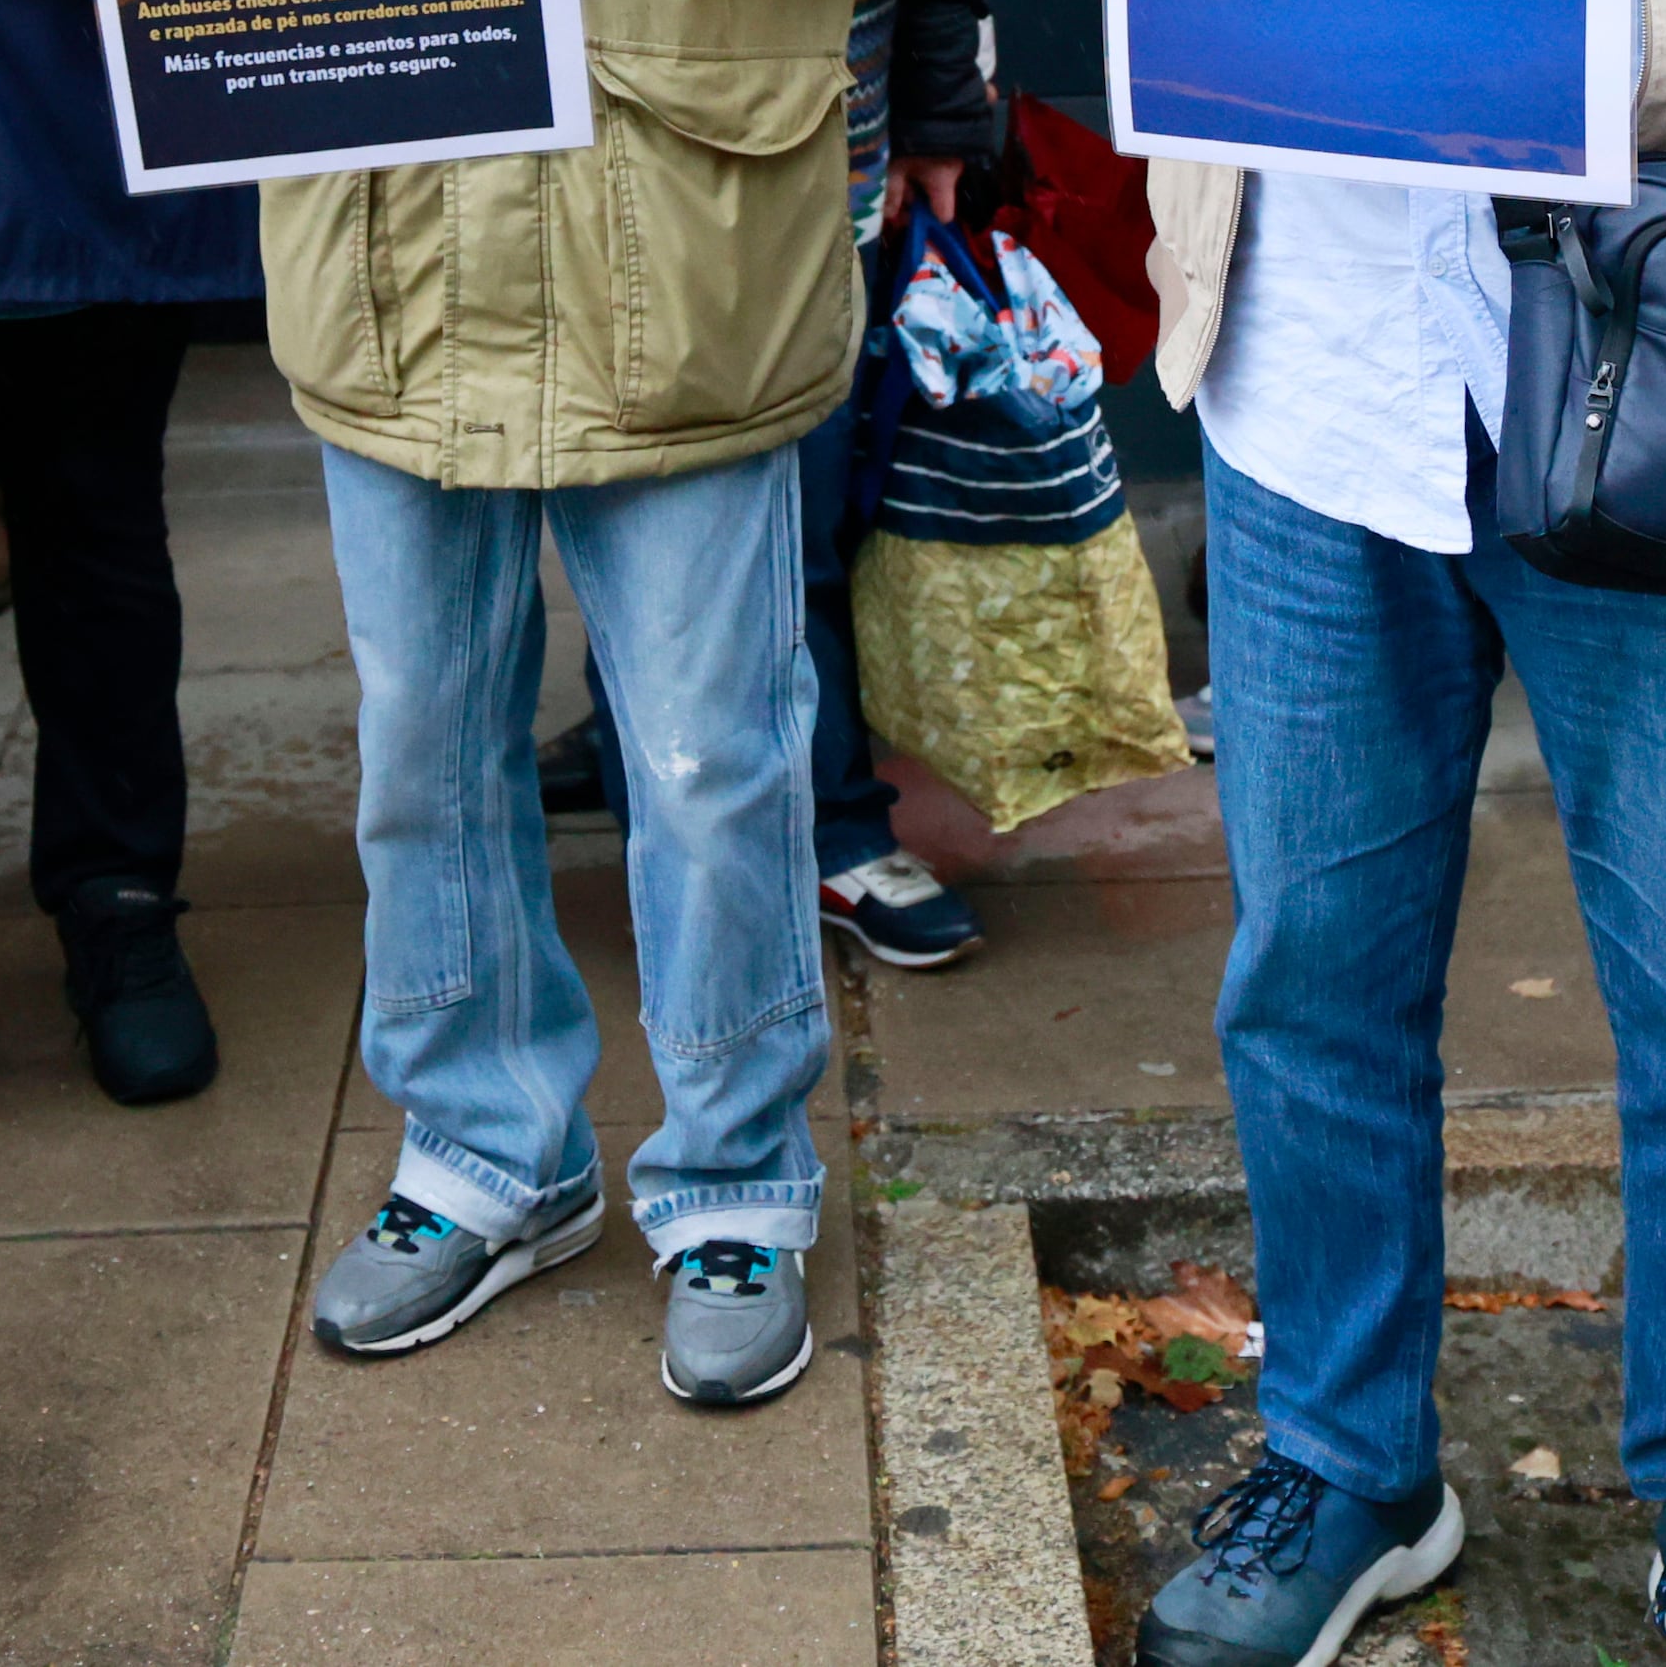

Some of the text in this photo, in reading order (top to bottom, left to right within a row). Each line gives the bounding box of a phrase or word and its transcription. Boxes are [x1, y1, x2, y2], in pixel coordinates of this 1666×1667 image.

[149, 27, 161, 42] e
[164, 17, 248, 43] rapazada
[250, 14, 273, 32] de
[301, 11, 332, 27] nos
[334, 3, 419, 24] corredores
[421, 0, 448, 15] con
[164, 24, 518, 74] Máis frecuencias e asentos para todos,
[225, 55, 457, 95] por un transporte seguro.
